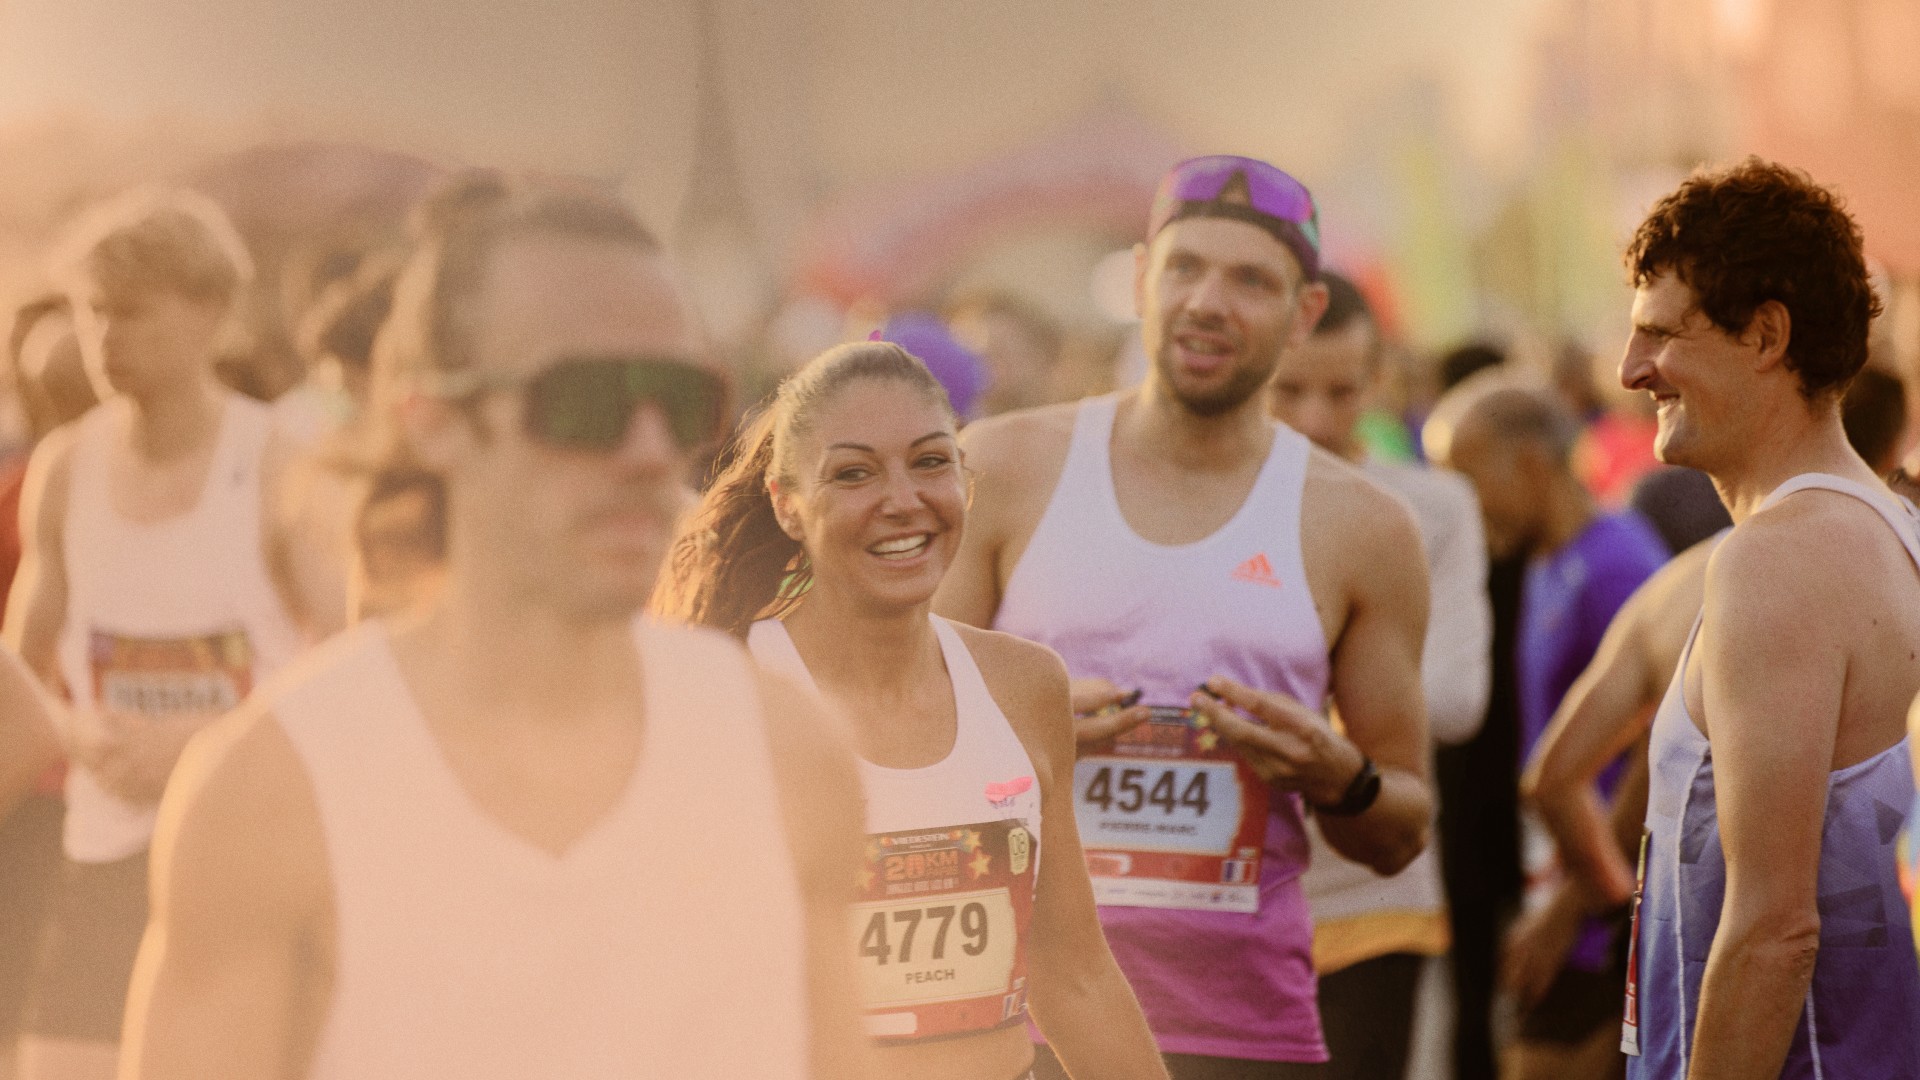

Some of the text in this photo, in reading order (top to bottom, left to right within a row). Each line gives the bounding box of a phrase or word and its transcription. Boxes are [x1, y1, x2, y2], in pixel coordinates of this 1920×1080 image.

[1085, 766, 1210, 816] 4544
[858, 902, 988, 966] 4779
[905, 968, 956, 984] PEACH
